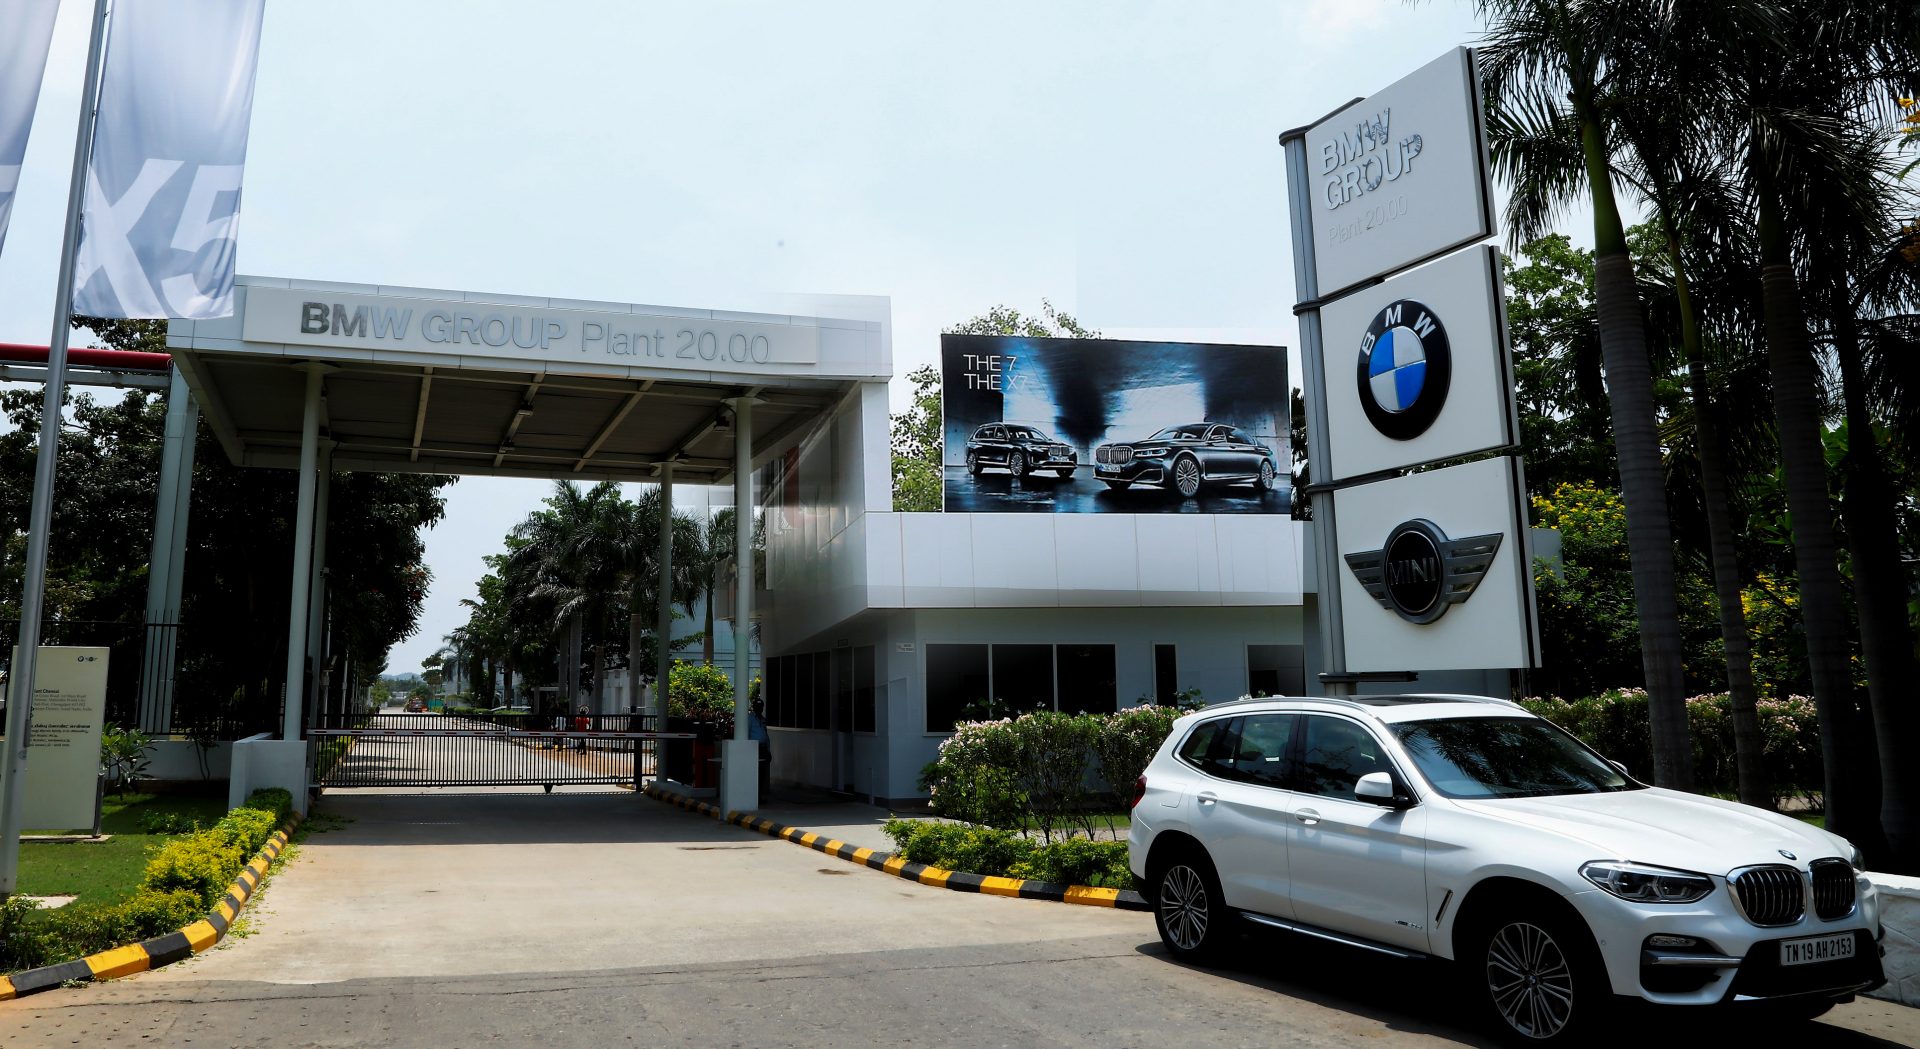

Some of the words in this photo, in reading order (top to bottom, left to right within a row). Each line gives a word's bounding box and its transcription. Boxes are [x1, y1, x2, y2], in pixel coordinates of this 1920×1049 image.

[1322, 107, 1391, 176] BMW
[1325, 134, 1423, 210] GROUP
[75, 158, 244, 320] X5
[1329, 217, 1363, 248] Plant
[1366, 193, 1408, 231] 20.00
[300, 301, 413, 341] BMW
[421, 309, 568, 350] GROUP
[581, 320, 665, 358] Plant
[675, 329, 770, 365] 20.00
[1361, 303, 1437, 356] BMW
[963, 354, 1001, 372] THE
[1006, 356, 1017, 372] 7
[963, 373, 1002, 391] THE
[1388, 557, 1437, 586] MINI
[1785, 944, 1799, 962] TN
[1801, 943, 1813, 961] 19
[1816, 941, 1828, 959] AH
[1830, 937, 1852, 957] 2153
